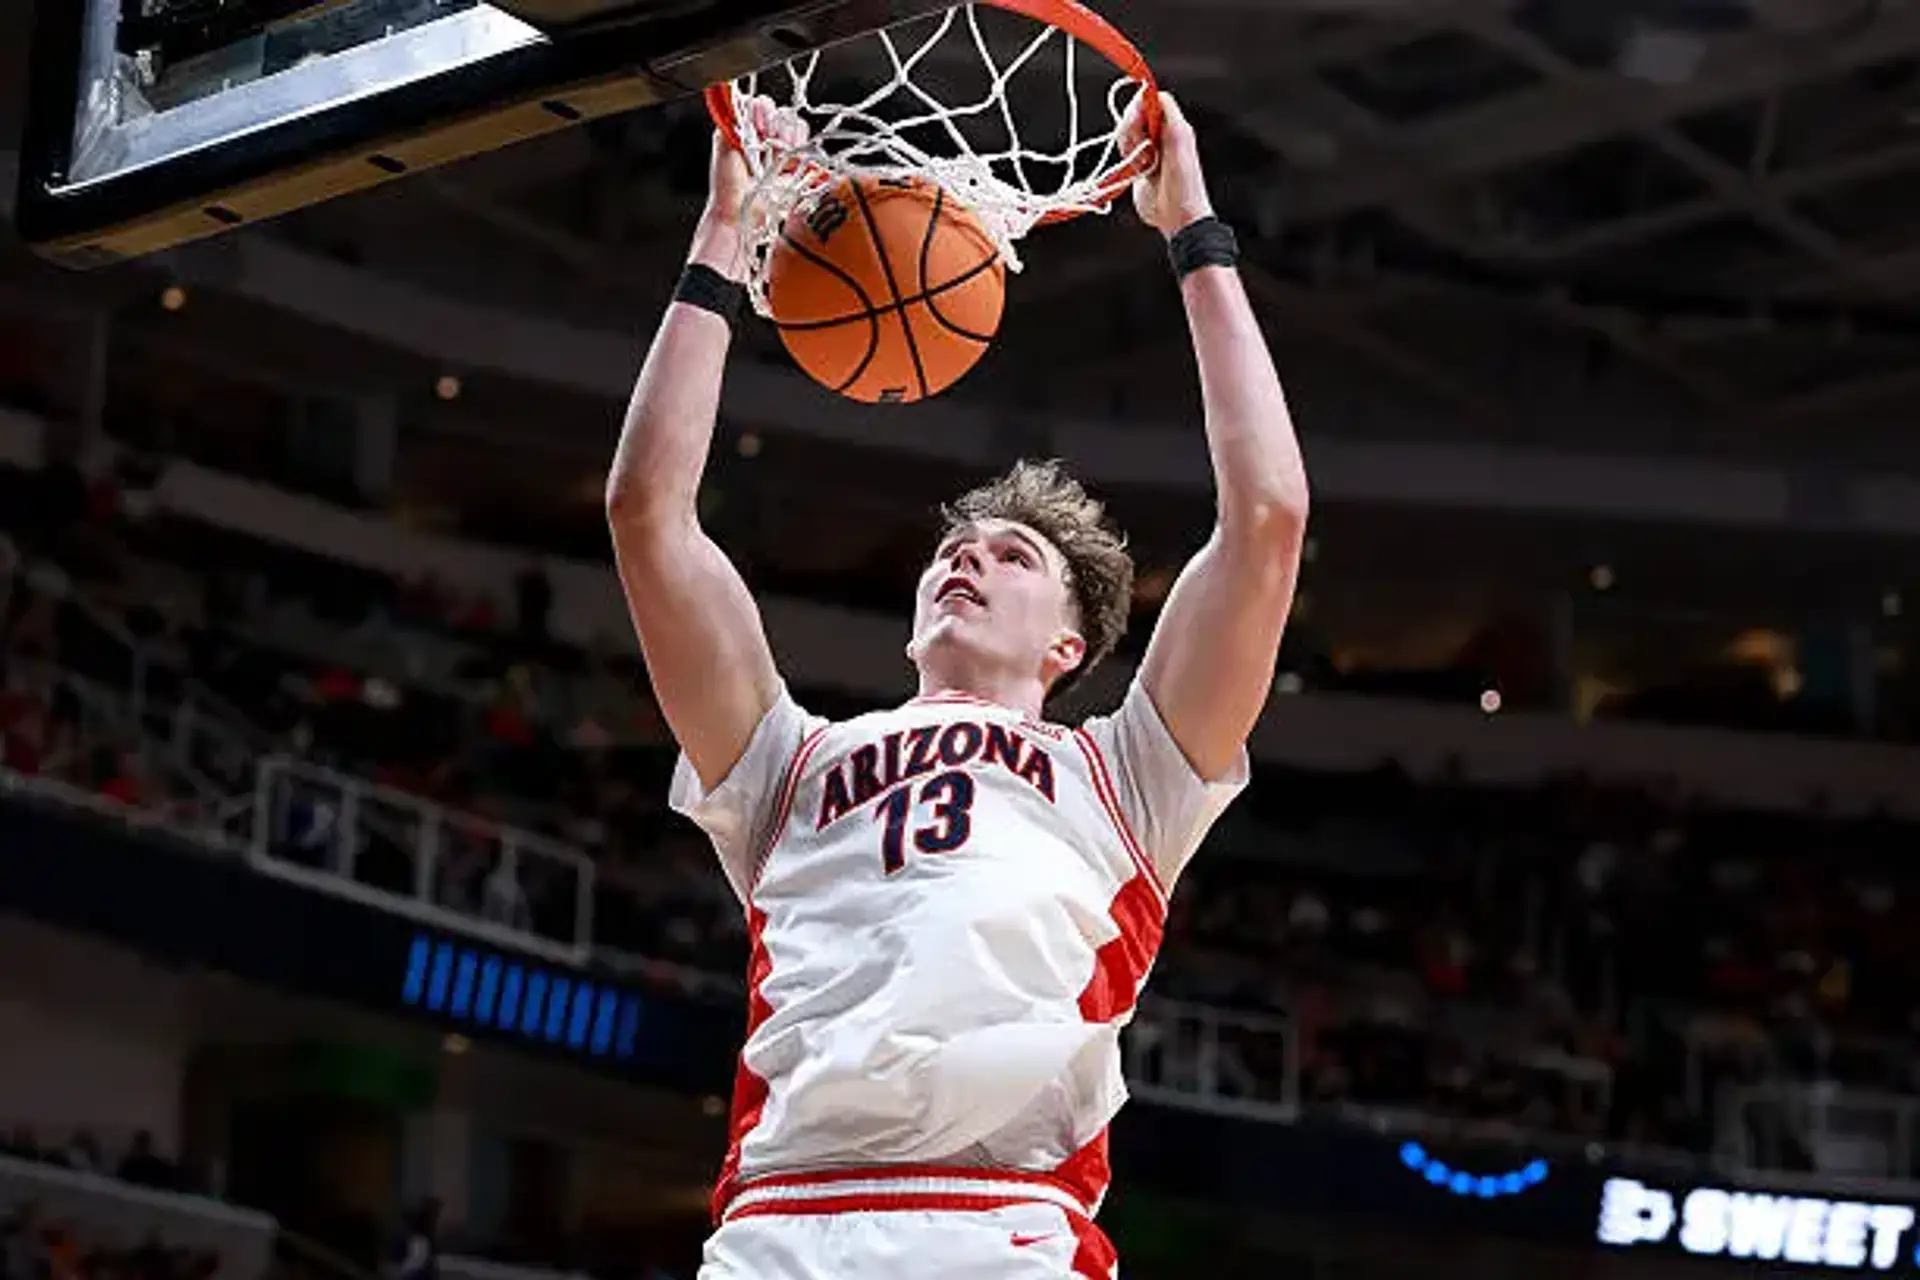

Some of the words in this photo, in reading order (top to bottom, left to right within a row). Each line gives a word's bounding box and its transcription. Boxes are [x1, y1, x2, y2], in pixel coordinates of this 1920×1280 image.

[817, 721, 1056, 831] ARIZONA
[875, 770, 975, 874] 13
[1681, 1189, 1914, 1269] SWEET
